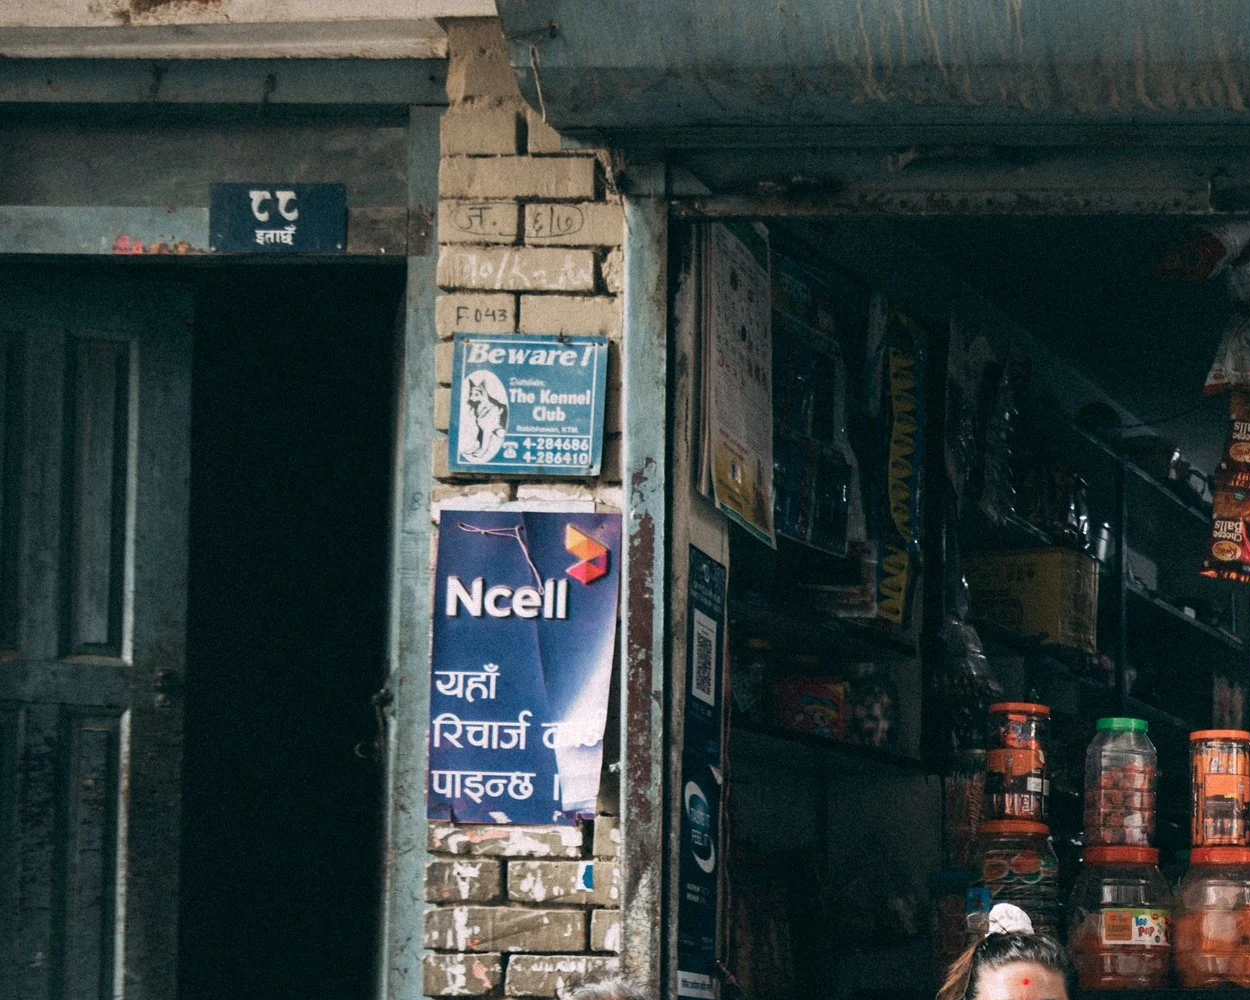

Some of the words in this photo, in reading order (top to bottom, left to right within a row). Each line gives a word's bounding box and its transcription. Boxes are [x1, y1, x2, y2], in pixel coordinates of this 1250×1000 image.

[508, 388, 536, 403] The
[540, 389, 592, 405] Kennel
[532, 406, 567, 421] Club
[523, 437, 589, 451] 4-284686
[523, 451, 588, 465] 4-286410
[1214, 520, 1242, 534] Balls
[1212, 530, 1242, 542] Cheese
[446, 576, 567, 619] Ncell
[434, 664, 500, 702] यहाँ
[432, 711, 533, 750] रिचार्ज
[431, 769, 536, 804] पाइन्छ
